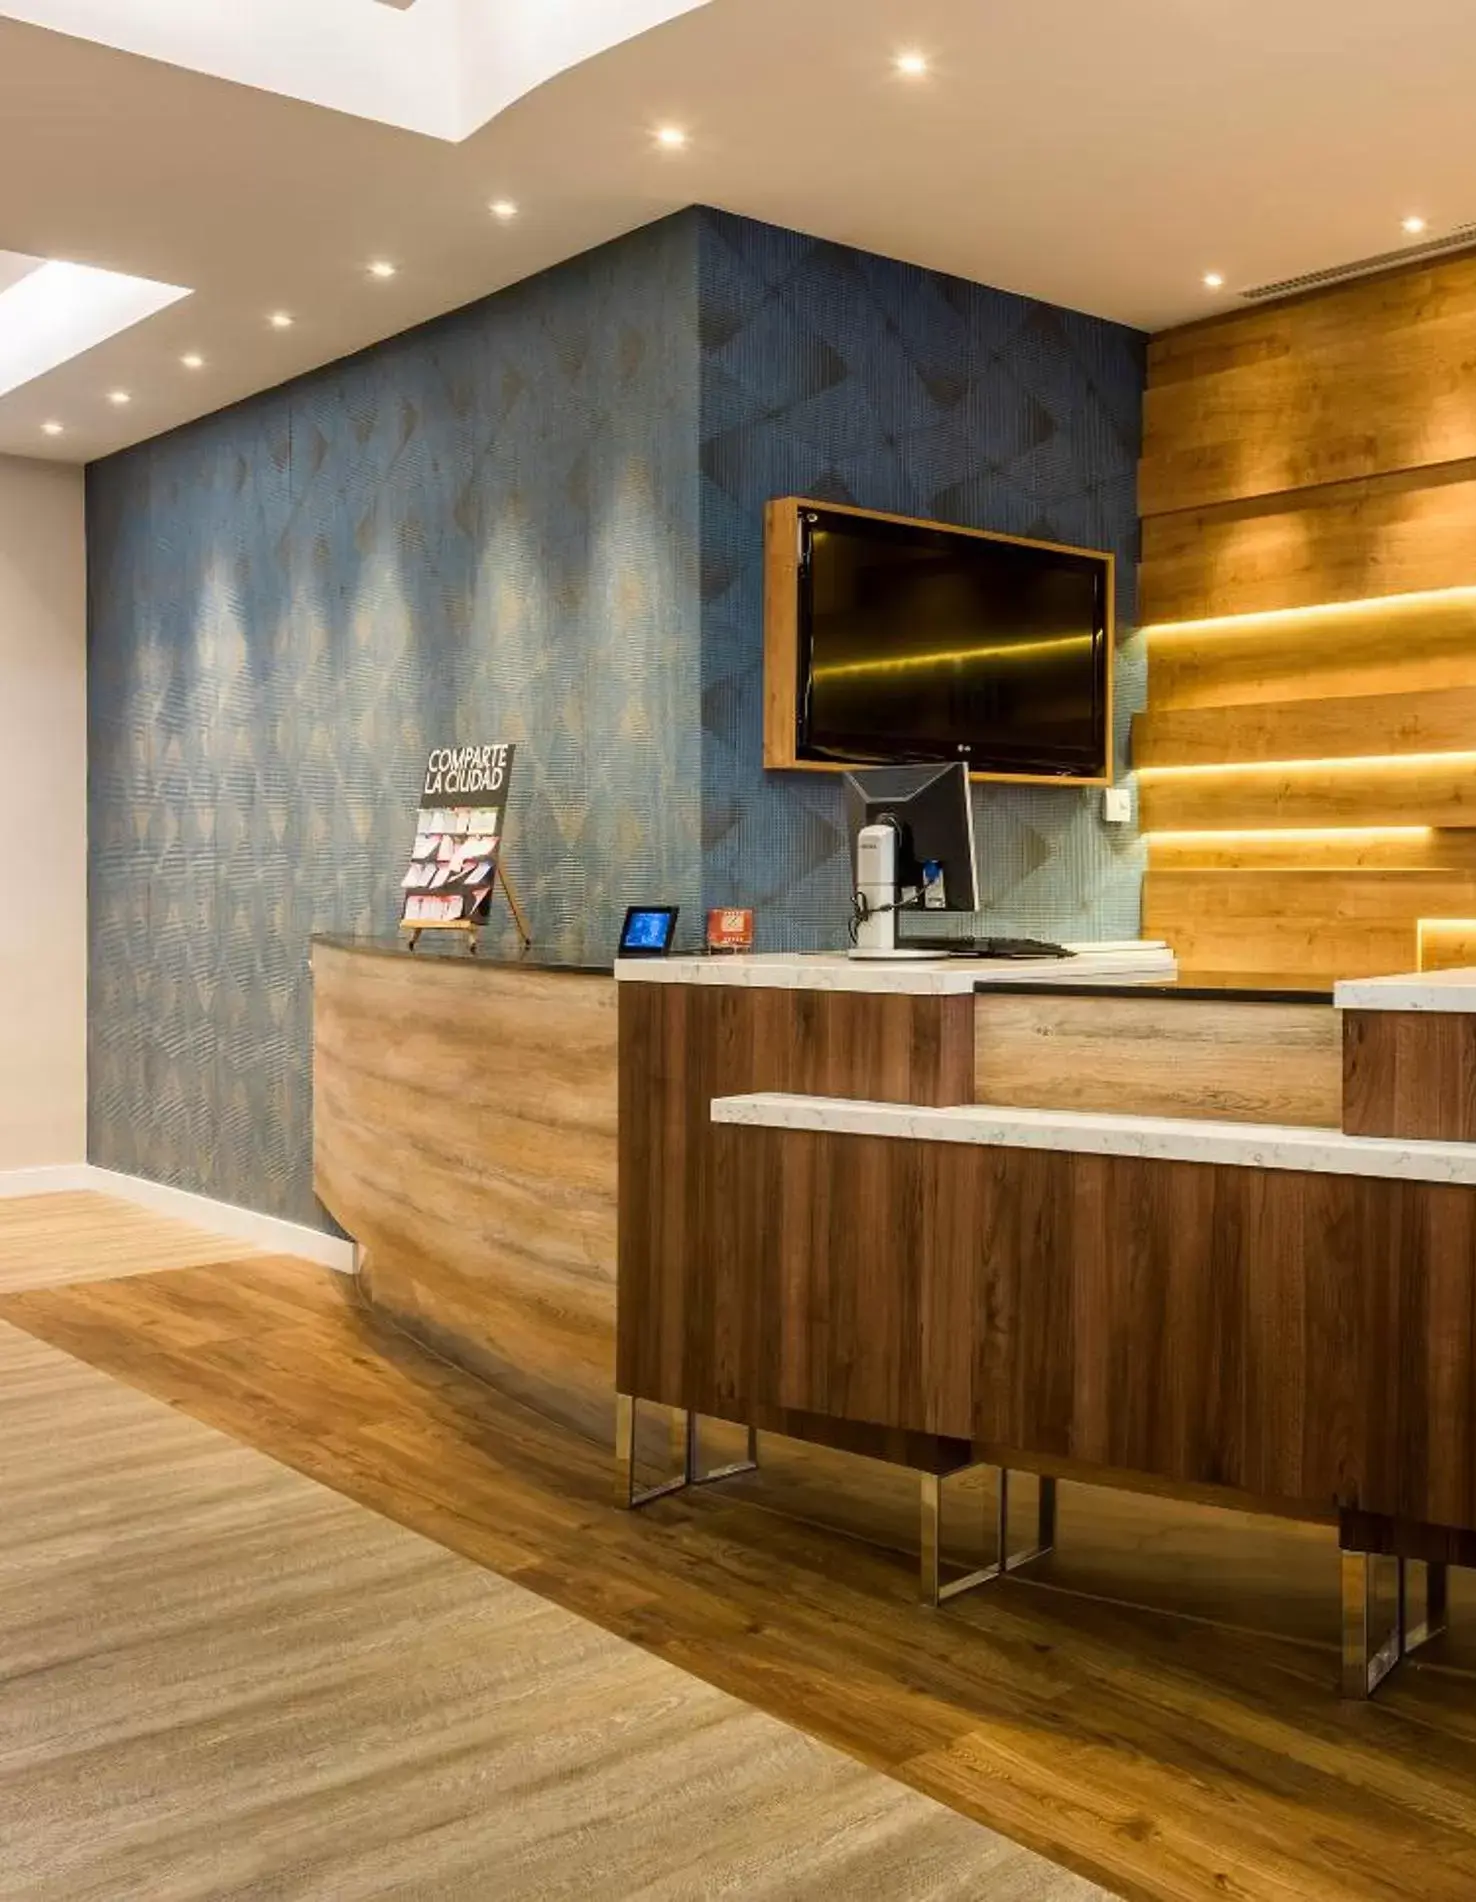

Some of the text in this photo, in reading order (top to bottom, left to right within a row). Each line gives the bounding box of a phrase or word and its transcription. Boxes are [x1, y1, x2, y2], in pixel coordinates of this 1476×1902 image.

[428, 743, 508, 772] COMPARTE
[424, 767, 503, 794] LA CIUDAD
